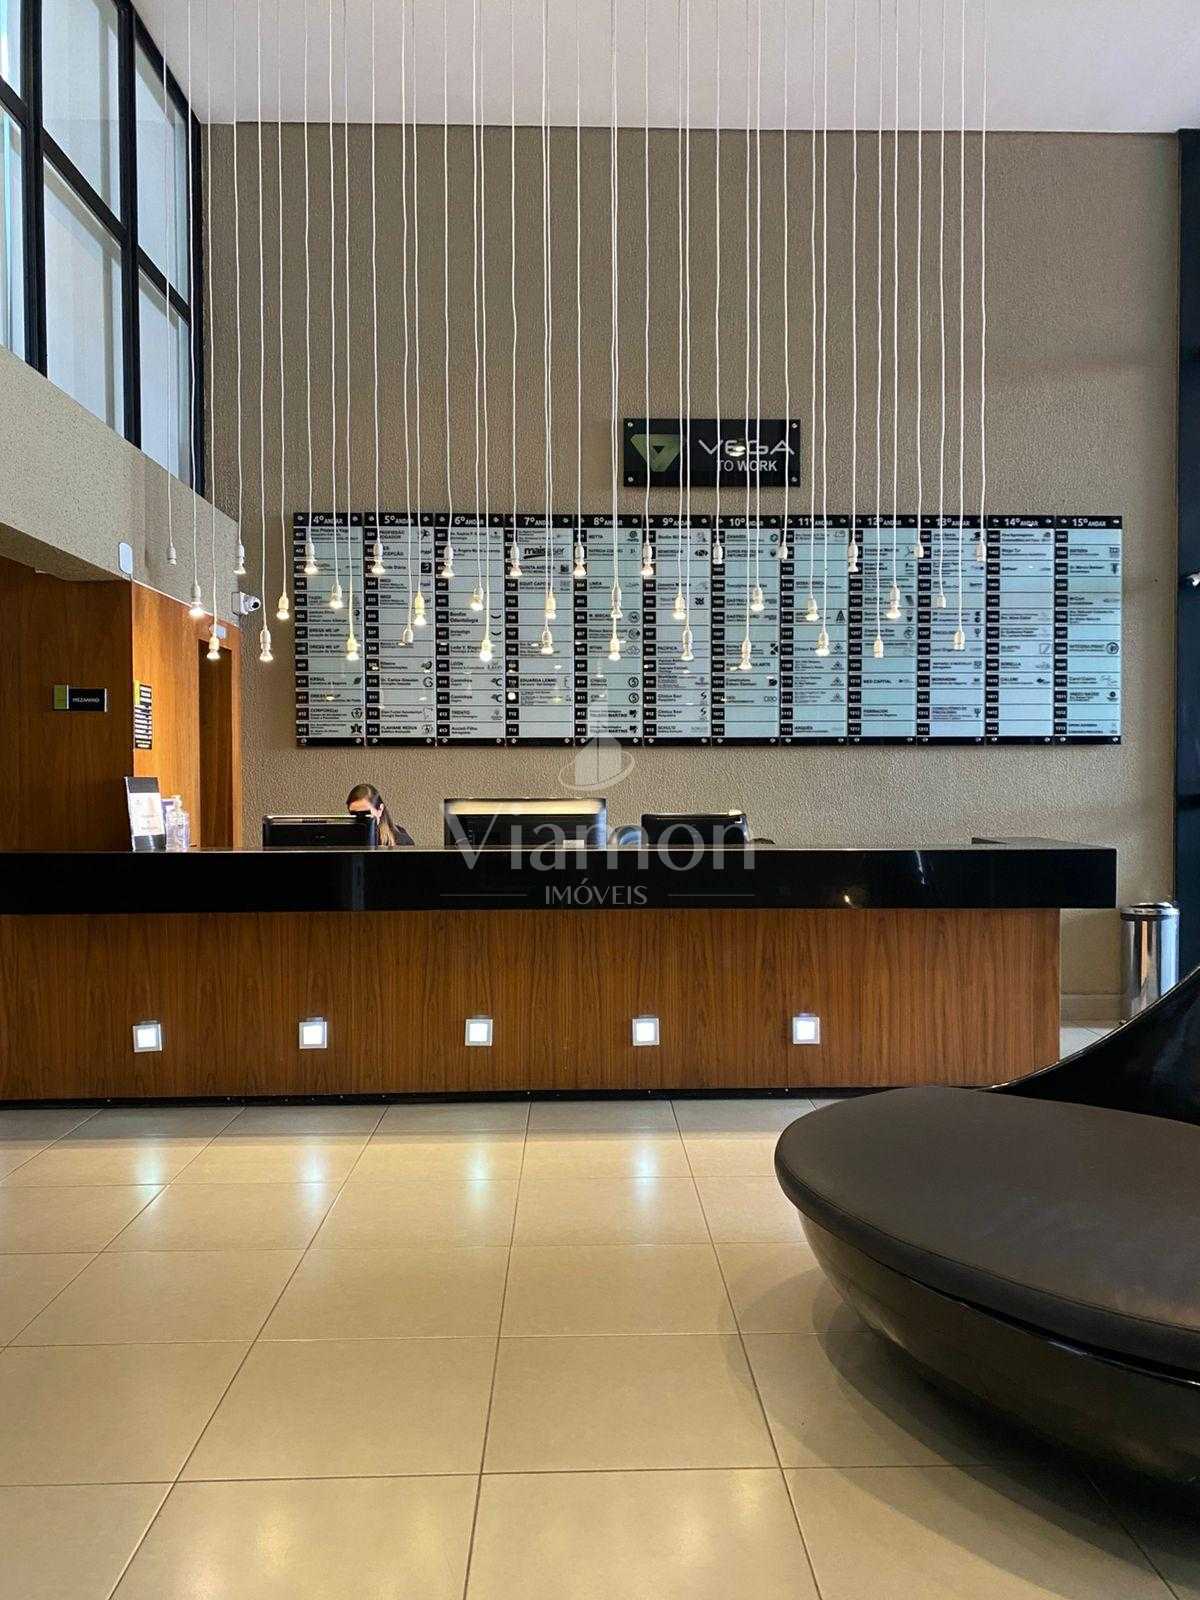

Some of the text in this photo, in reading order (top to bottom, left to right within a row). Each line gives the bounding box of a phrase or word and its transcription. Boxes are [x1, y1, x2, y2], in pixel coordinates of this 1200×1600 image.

[698, 440, 794, 455] VEGA
[738, 460, 778, 472] WORK
[313, 516, 324, 524] 4º
[384, 516, 395, 524] 5º
[455, 516, 465, 525] 6º
[524, 517, 535, 525] 7º
[662, 518, 673, 526] 9º
[730, 518, 745, 526] 10º
[1072, 518, 1088, 526] 15º
